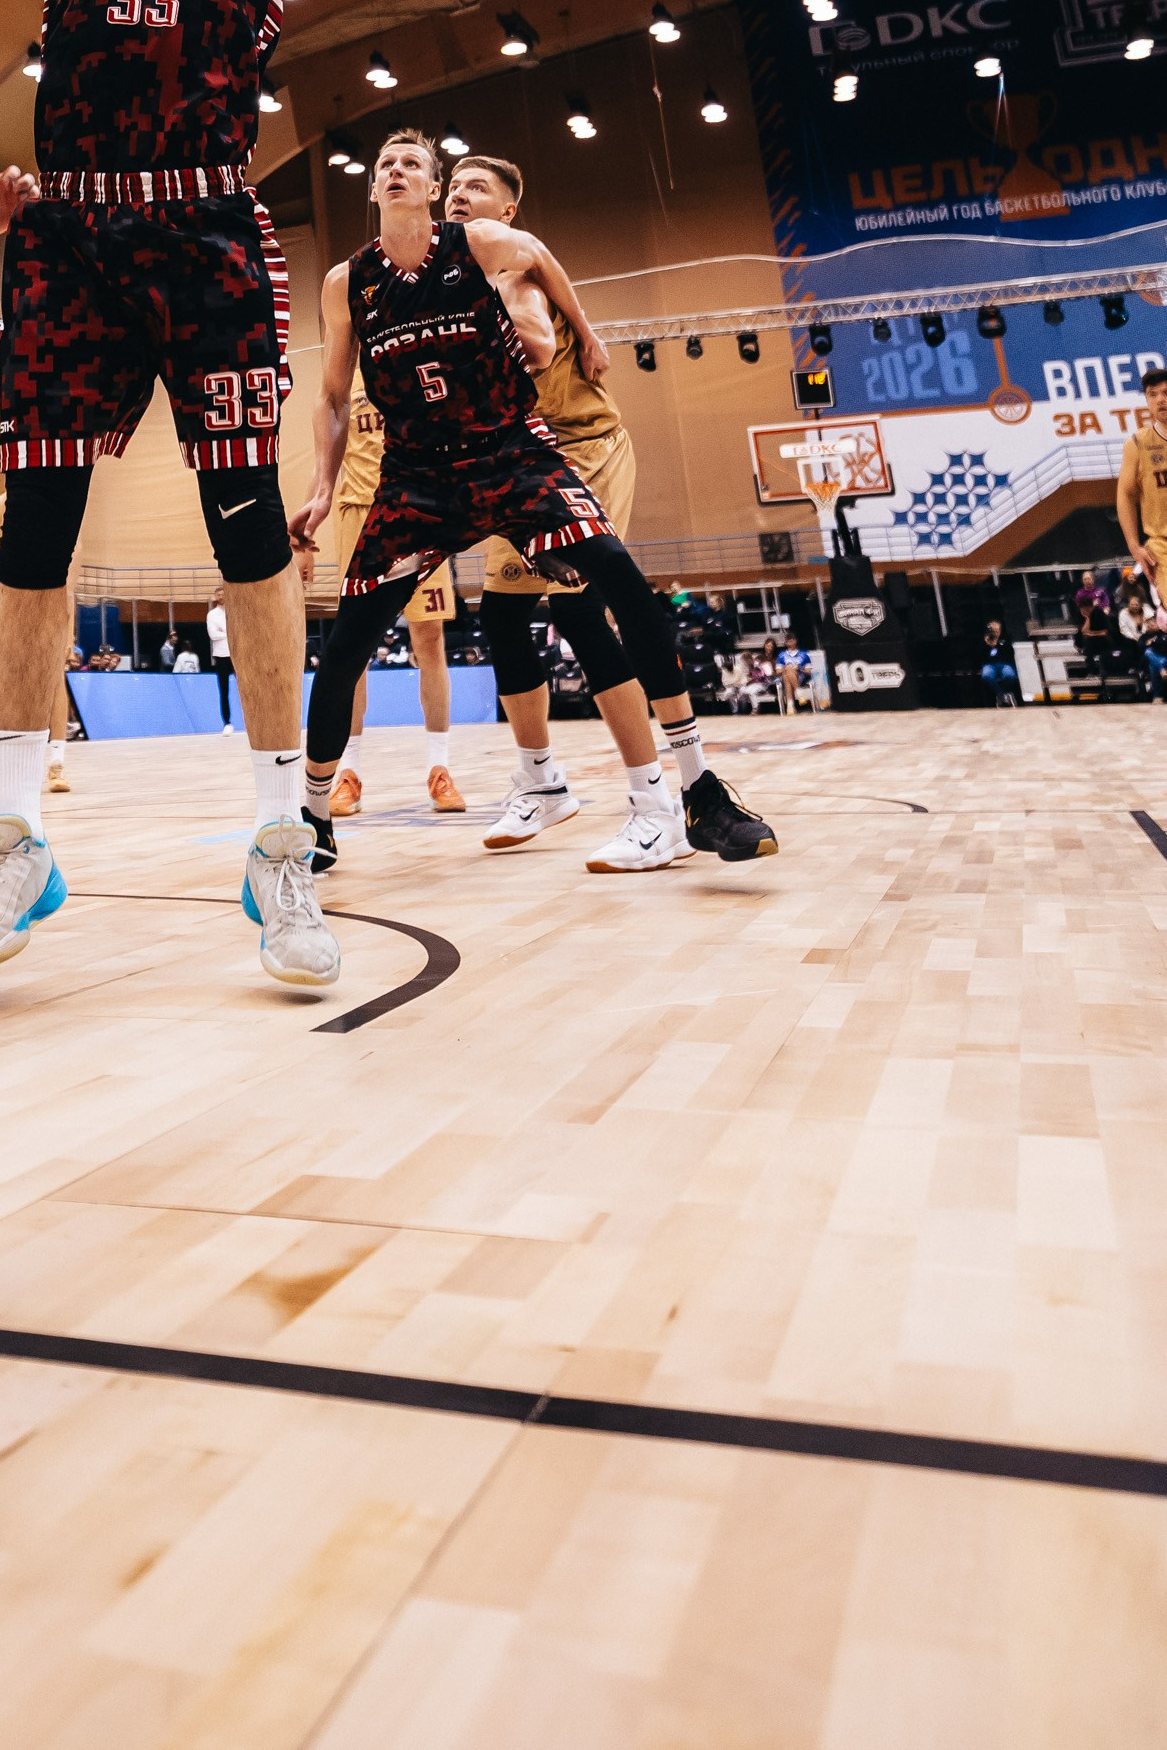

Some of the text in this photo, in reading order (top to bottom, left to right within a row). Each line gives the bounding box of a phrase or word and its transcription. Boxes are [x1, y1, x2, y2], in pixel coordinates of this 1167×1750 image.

[848, 131, 1167, 212] ЦЕЛЬ ОДН
[855, 205, 949, 232] ЮБИЛЕЙНЫЙ
[952, 200, 981, 219] ГОД
[1125, 179, 1167, 200] КЛУБ
[370, 322, 477, 364] РЯЗАНЬ
[415, 361, 448, 402] 5
[862, 329, 978, 402] 2026
[204, 367, 279, 431] 33
[1052, 410, 1103, 437] ЗА
[558, 487, 599, 518] 5
[422, 588, 446, 613] 31
[835, 660, 871, 693] 10
